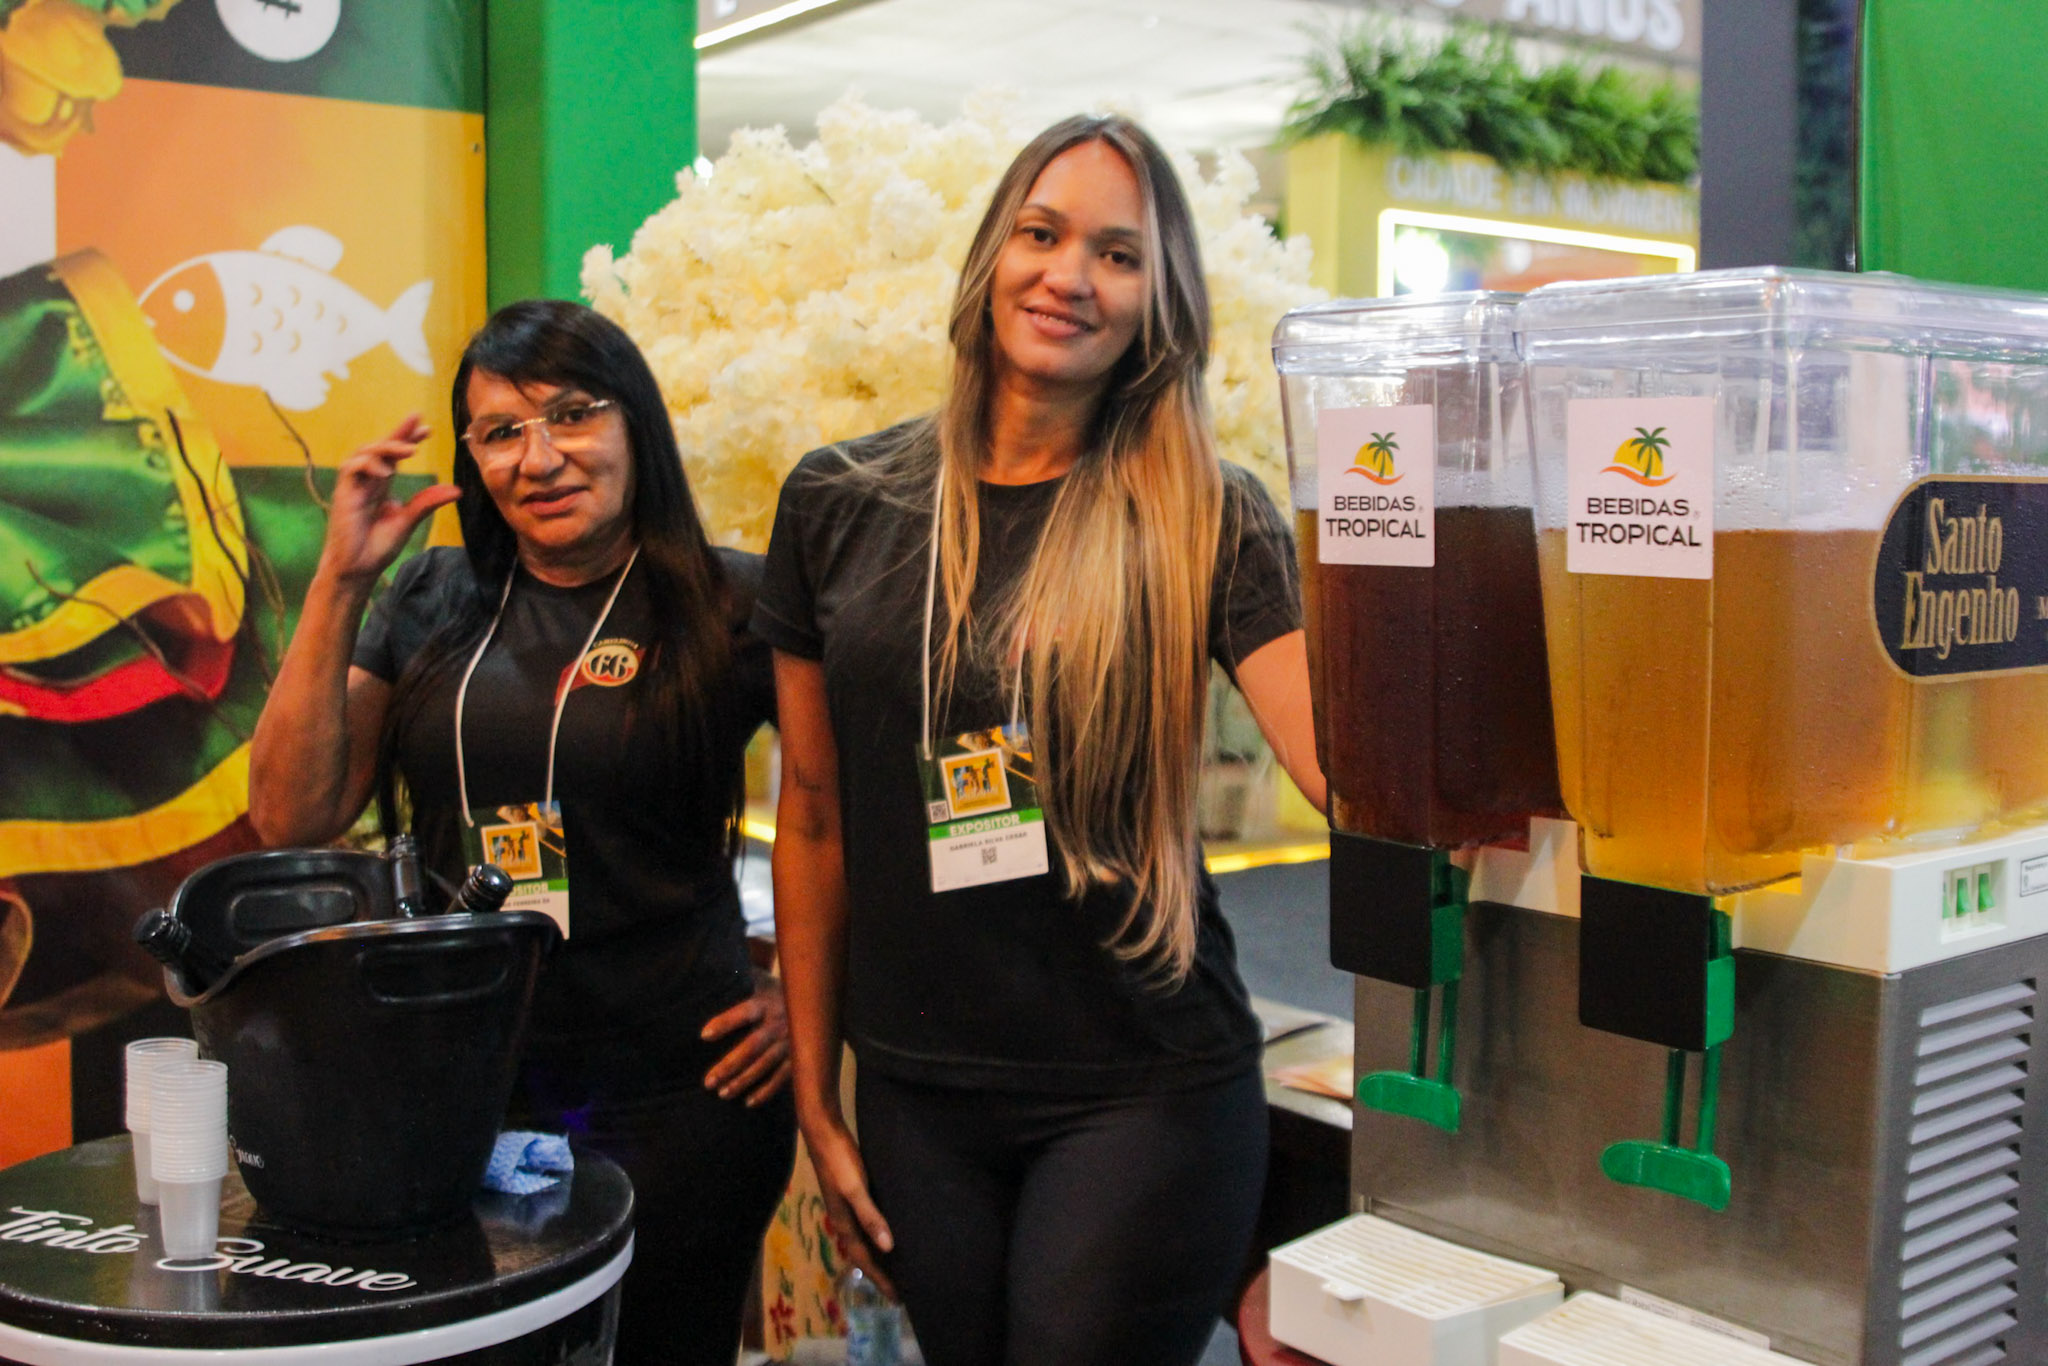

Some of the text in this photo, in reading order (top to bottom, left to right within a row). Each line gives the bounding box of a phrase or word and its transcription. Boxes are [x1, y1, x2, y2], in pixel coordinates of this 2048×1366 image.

[1333, 495, 1416, 512] BEBIDAS
[1586, 496, 1690, 517] BEBIDAS
[1325, 517, 1427, 539] TROPICAL
[1575, 521, 1703, 548] TROPICAL
[1926, 497, 2004, 576] Santo
[1900, 570, 2020, 661] Engenho
[949, 813, 1021, 836] EXPOSITOR
[509, 881, 549, 897] OSITOR
[0, 1205, 418, 1292] Tinto Suave
